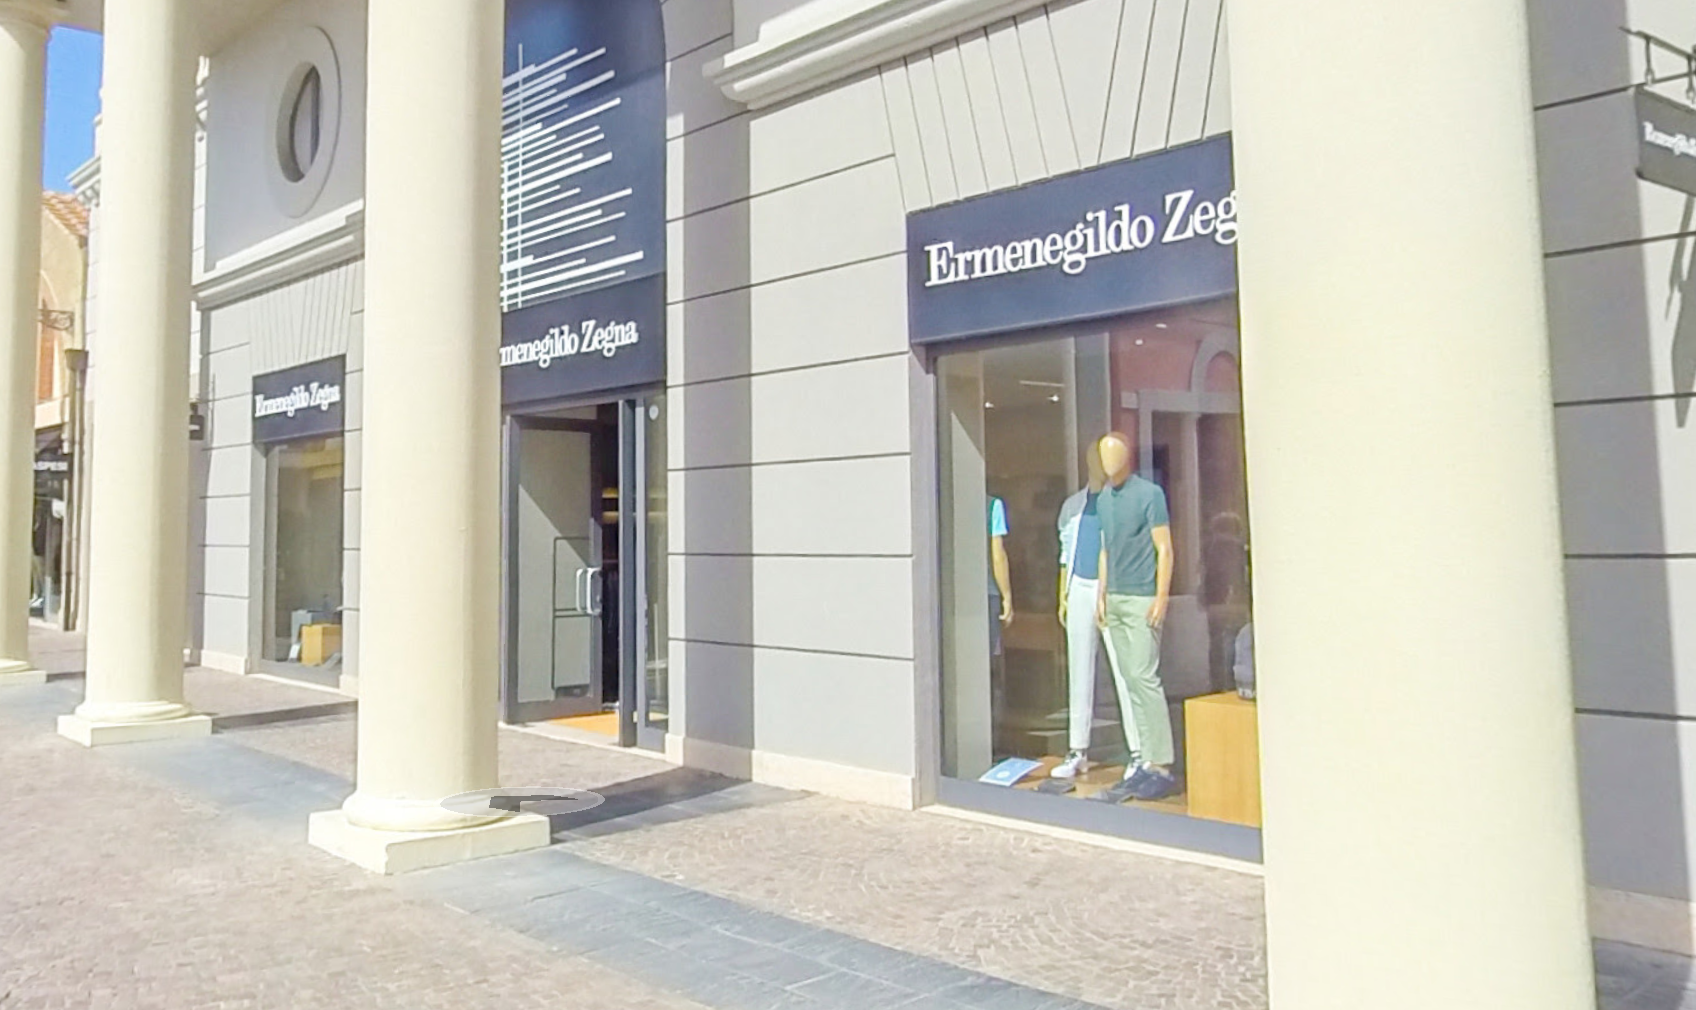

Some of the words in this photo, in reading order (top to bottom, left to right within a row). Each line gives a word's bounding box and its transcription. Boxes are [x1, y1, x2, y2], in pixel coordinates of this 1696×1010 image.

[924, 203, 1156, 286] Ermenegildo
[499, 324, 580, 368] menegildo
[580, 319, 639, 358] Zegna
[254, 384, 310, 417] Ermenegildo
[309, 381, 341, 411] Zegna
